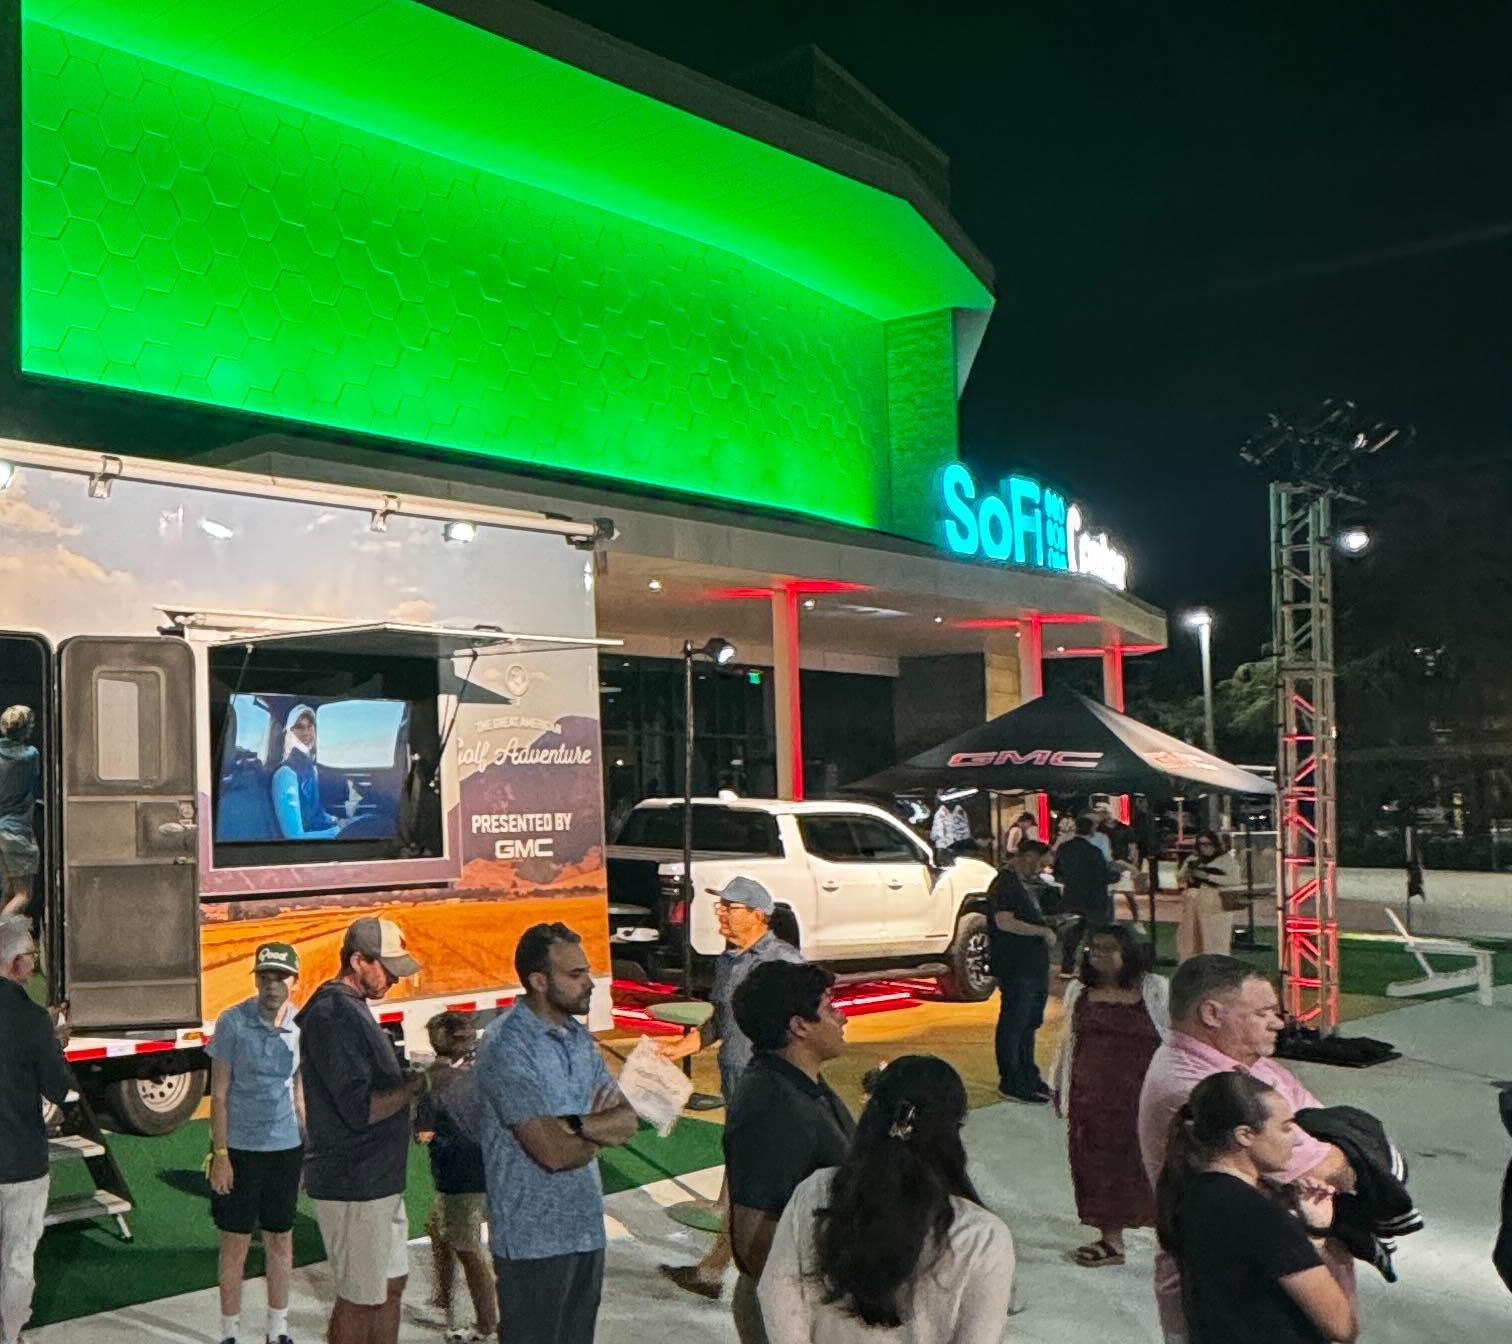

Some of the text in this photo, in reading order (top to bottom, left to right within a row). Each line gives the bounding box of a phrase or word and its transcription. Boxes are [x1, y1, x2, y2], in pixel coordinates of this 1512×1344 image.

[943, 464, 1043, 566] SoFi
[493, 736, 592, 766] Adventure
[947, 749, 1104, 768] GMC
[471, 812, 573, 834] PRESENTED BY
[494, 838, 554, 859] GMC
